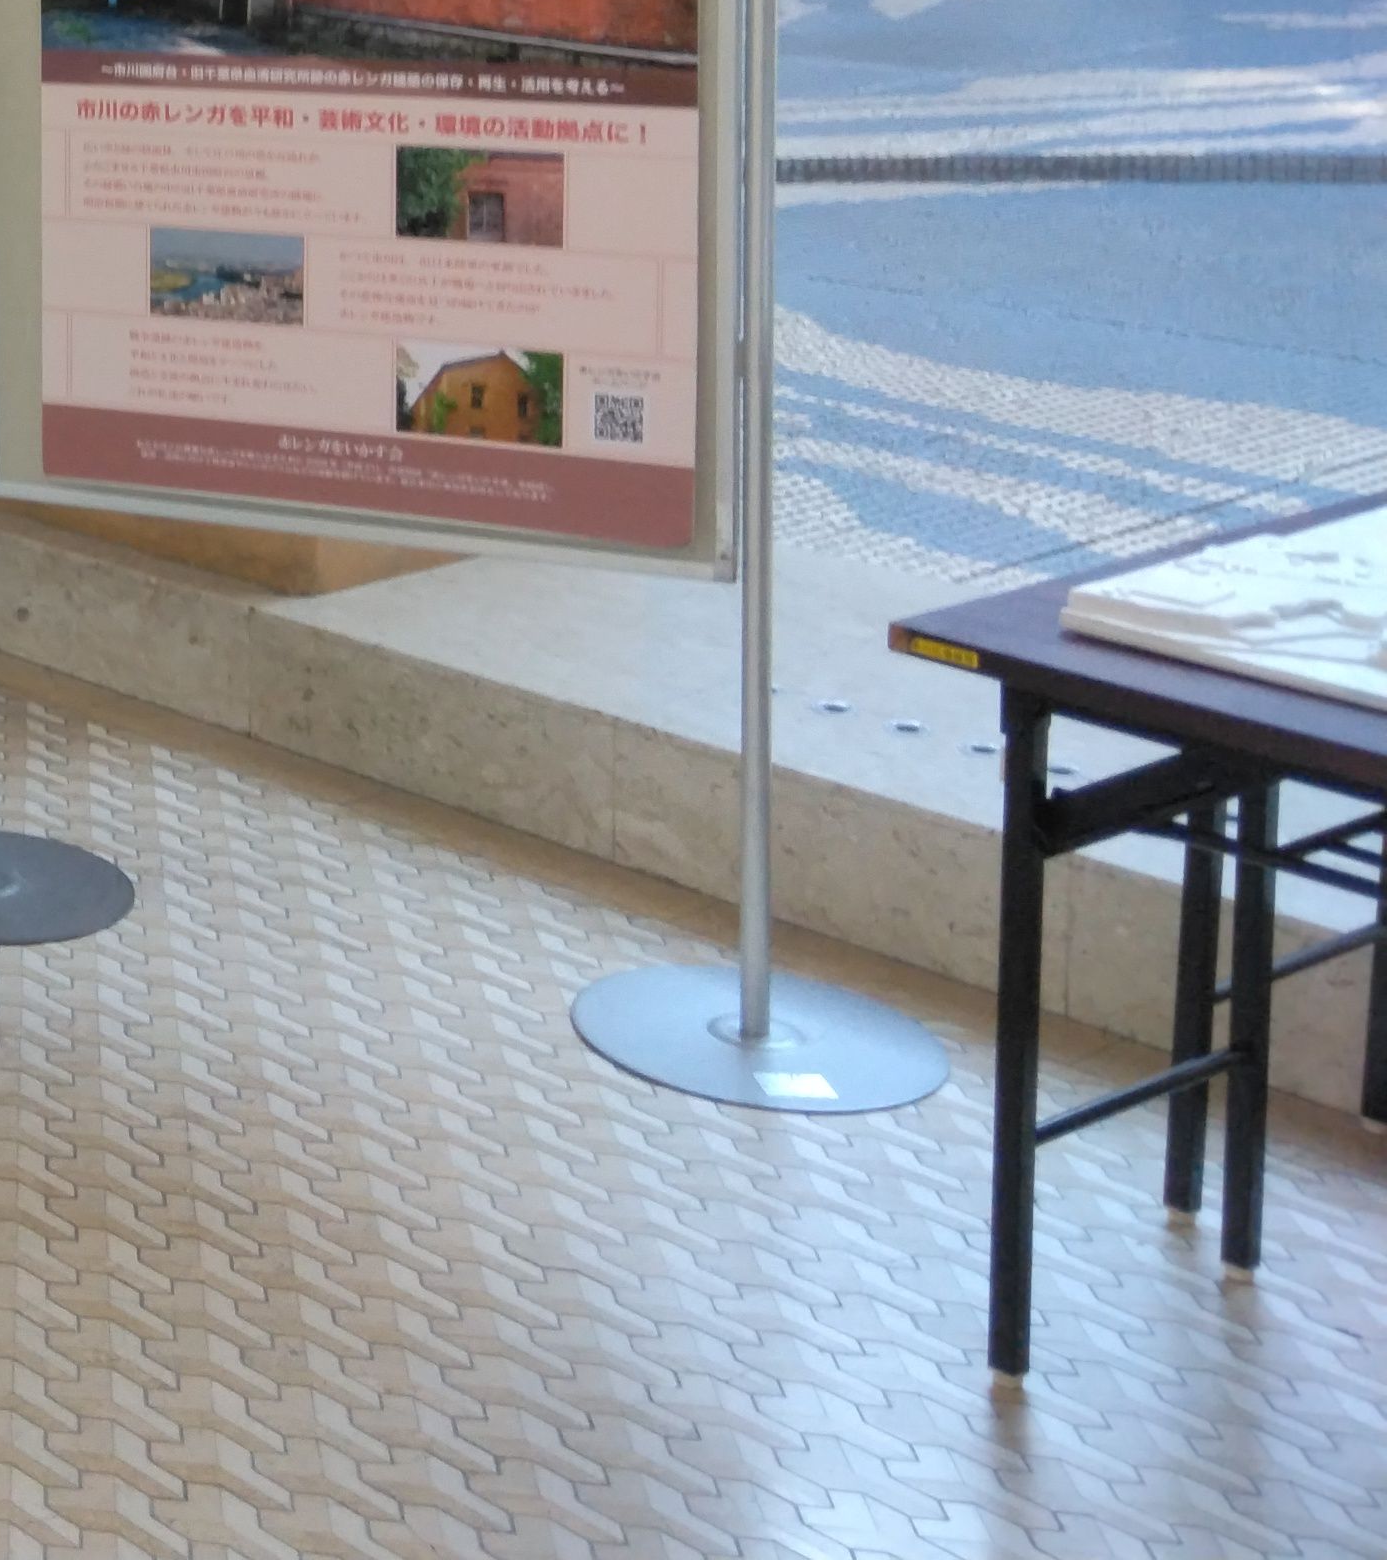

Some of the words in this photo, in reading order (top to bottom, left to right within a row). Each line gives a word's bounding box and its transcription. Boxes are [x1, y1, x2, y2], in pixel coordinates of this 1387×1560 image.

[75, 98, 649, 145] 市川の赤レンガを平和・芸術文化・環境の活動拠点に！
